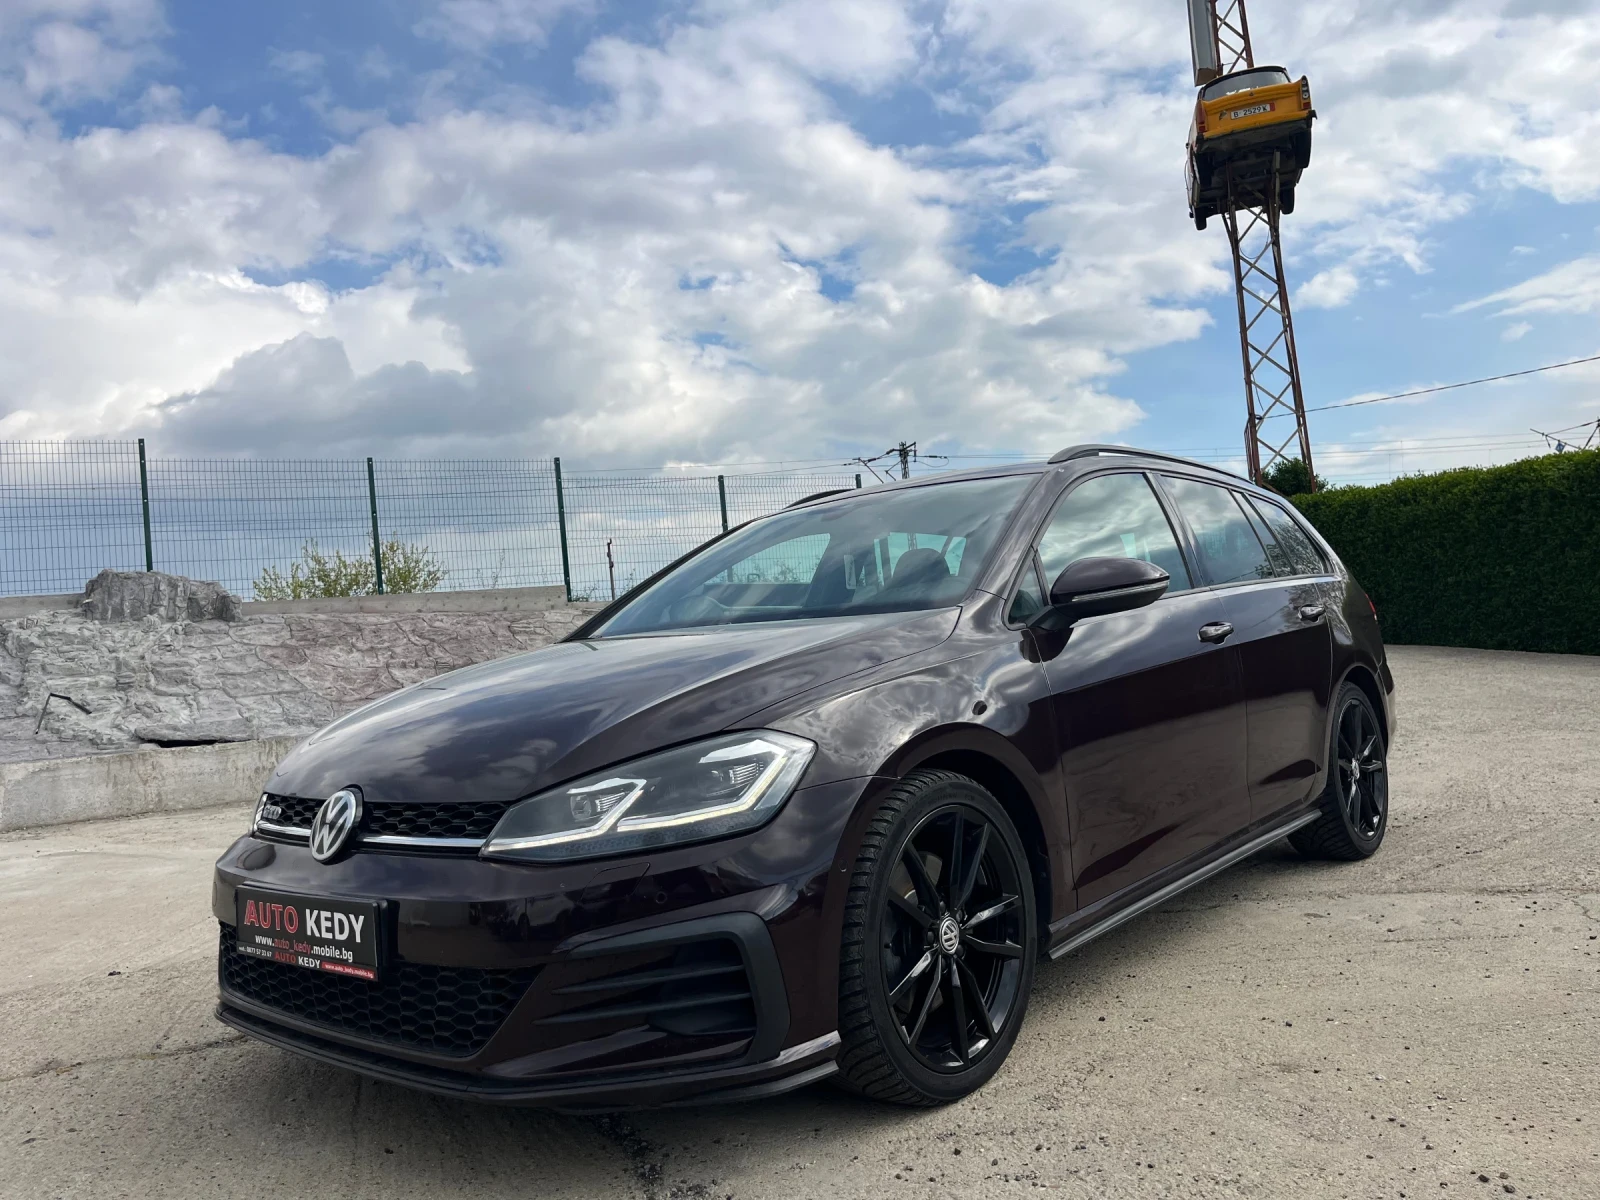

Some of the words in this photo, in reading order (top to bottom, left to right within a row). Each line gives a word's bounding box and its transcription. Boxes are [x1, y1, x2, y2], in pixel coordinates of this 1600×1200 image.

[244, 899, 299, 933] AUTO
[305, 908, 365, 943] KEDY
[254, 934, 354, 963] www.auto_kedy.mobile.bg
[274, 951, 297, 964] AUTO
[298, 955, 321, 969] KEDY
